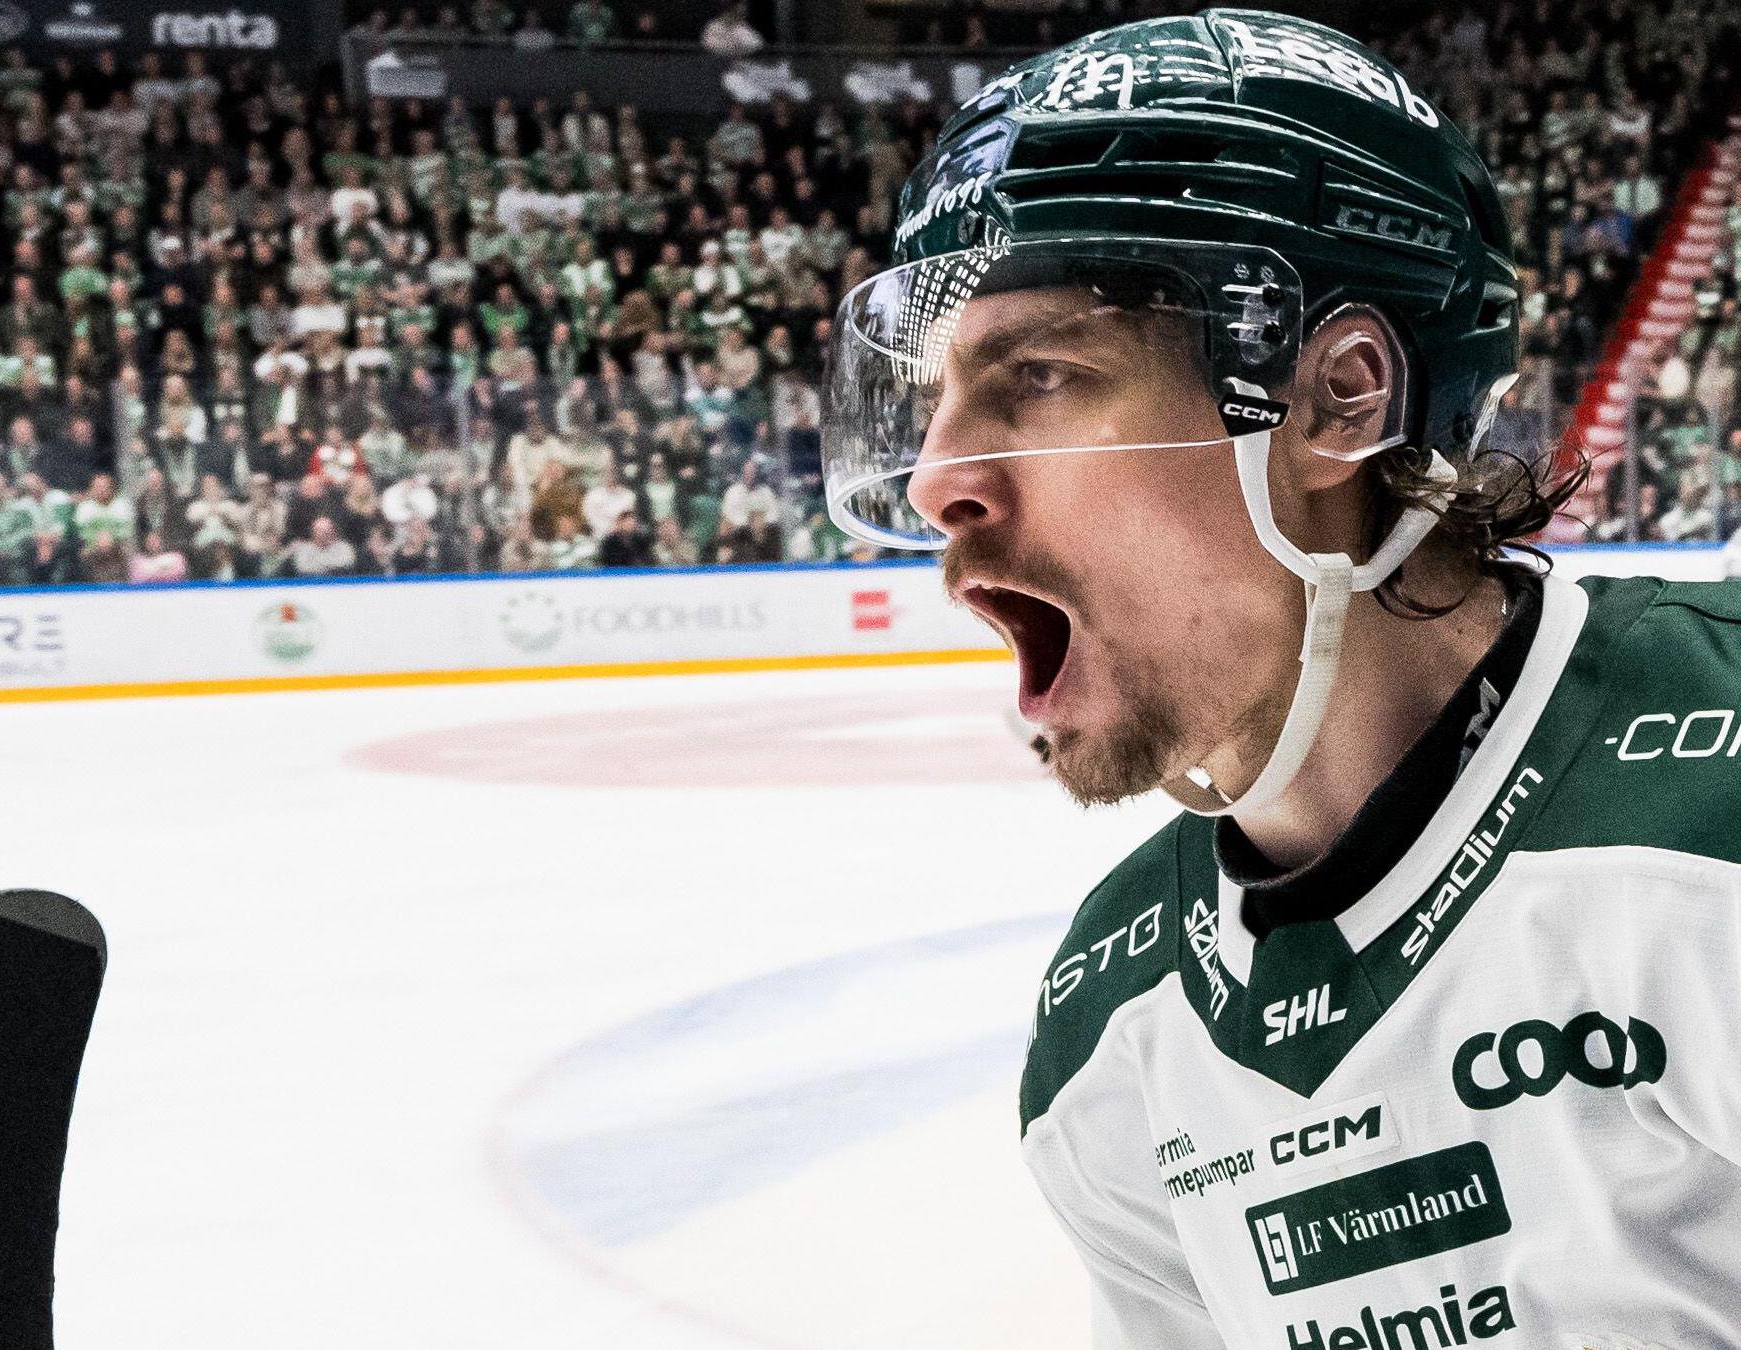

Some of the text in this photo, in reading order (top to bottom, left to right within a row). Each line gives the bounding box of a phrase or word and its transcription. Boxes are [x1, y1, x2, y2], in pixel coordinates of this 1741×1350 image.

[153, 12, 278, 49] renta
[1335, 204, 1452, 250] CCM
[1223, 403, 1281, 424] CCM
[574, 600, 765, 635] FOODHILLS
[1401, 766, 1543, 966] stadium
[1265, 985, 1347, 1046] SHL
[1270, 1105, 1381, 1165] CCM
[1297, 1174, 1488, 1256] LF Värmland
